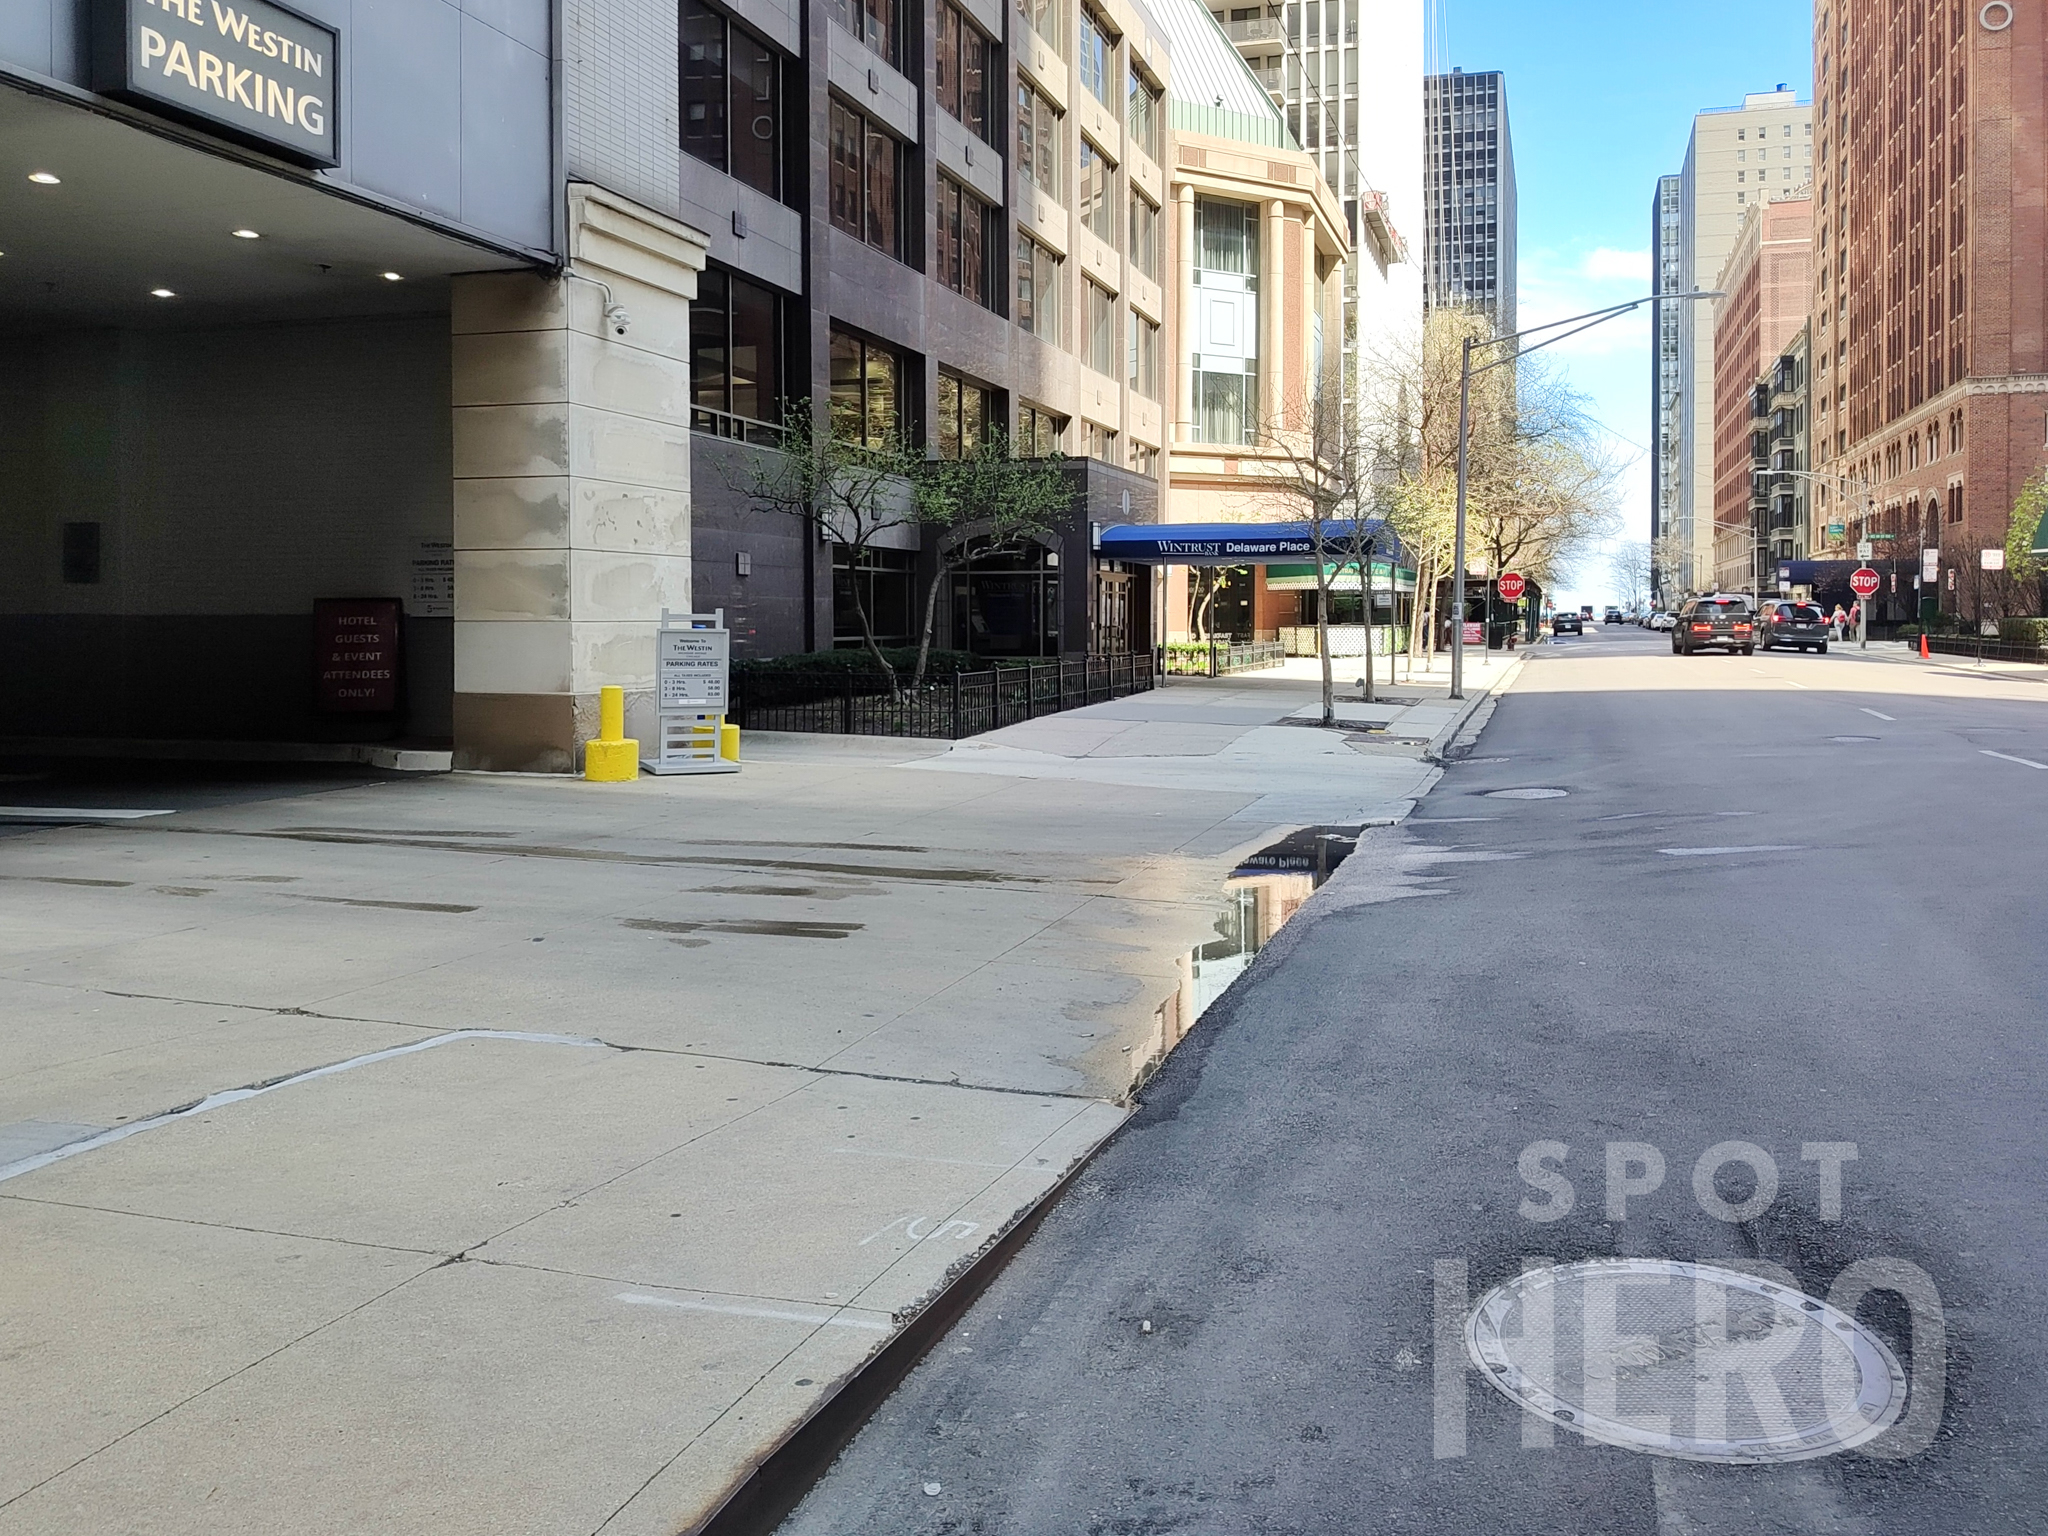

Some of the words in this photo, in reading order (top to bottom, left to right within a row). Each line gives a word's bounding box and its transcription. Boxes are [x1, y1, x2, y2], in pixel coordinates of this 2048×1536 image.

[212, 0, 322, 78] WESTIN
[140, 25, 324, 136] PARKING
[1157, 541, 1221, 552] WINTRUST
[1226, 542, 1277, 553] Delaware
[1279, 541, 1310, 552] Place
[1500, 580, 1523, 591] STOP
[1852, 575, 1878, 587] STOP
[338, 616, 377, 626] HOTEL
[335, 634, 380, 643] GUESTS
[332, 652, 341, 661] &
[345, 652, 383, 661] EVENT
[323, 670, 391, 680] ATTENDEES
[338, 688, 376, 698] ONLY!
